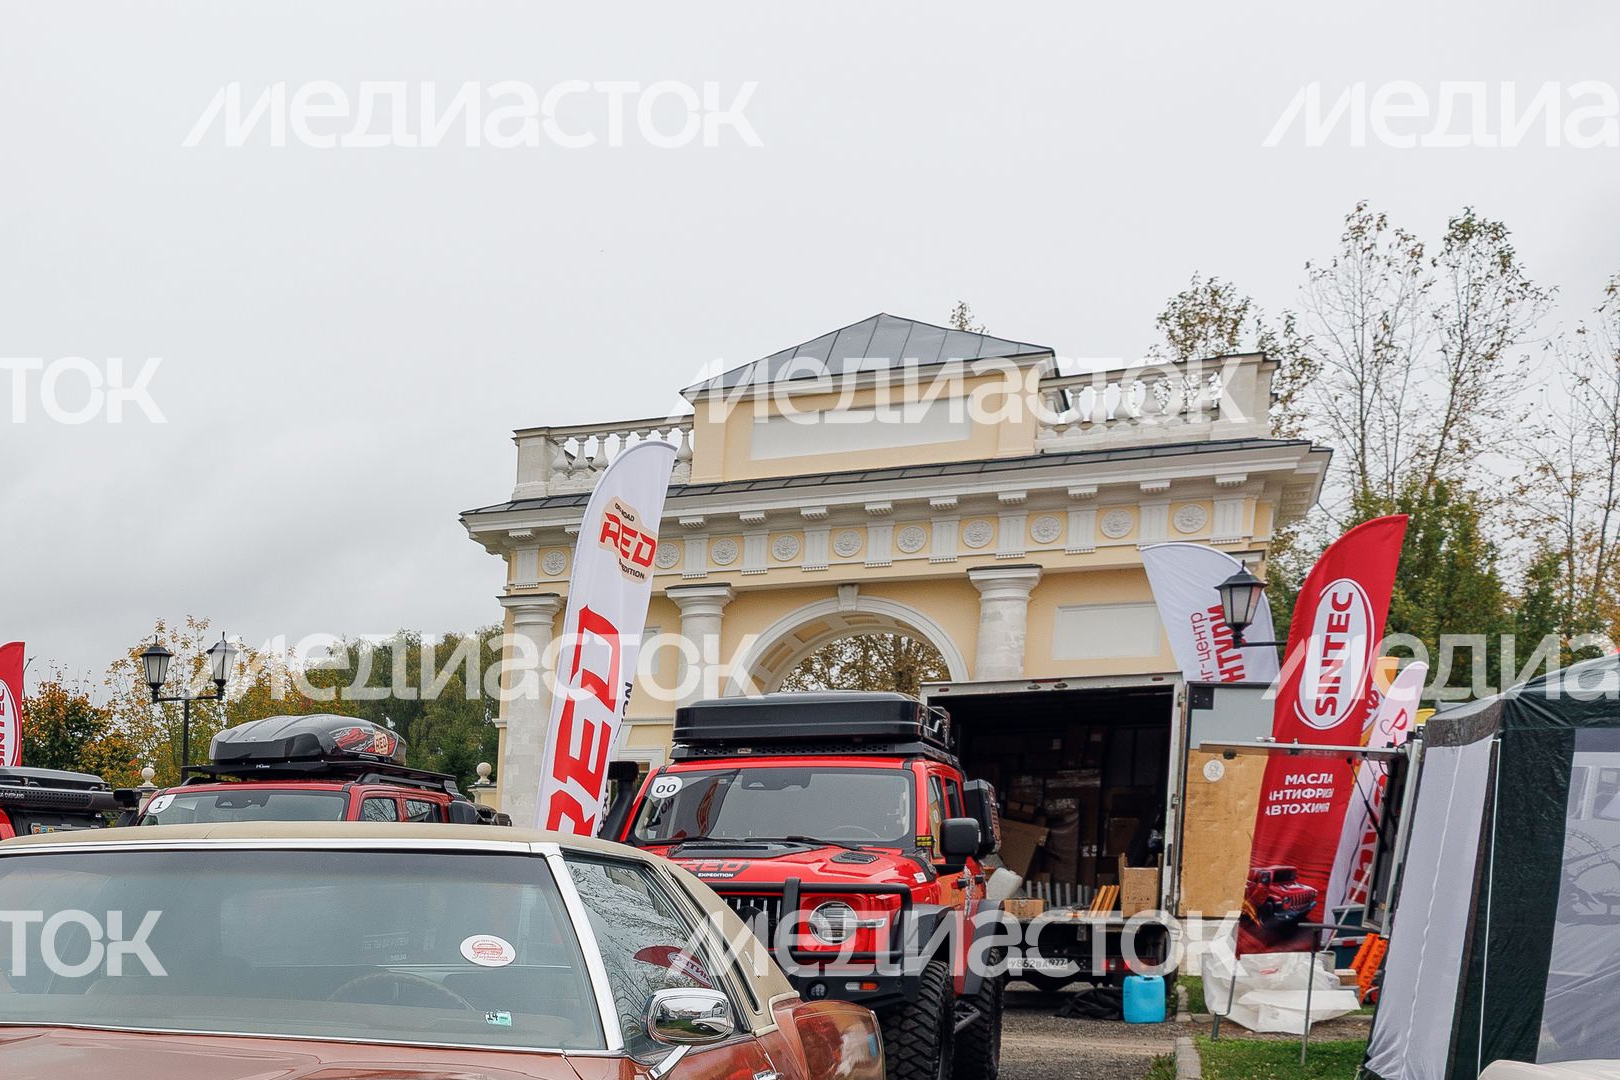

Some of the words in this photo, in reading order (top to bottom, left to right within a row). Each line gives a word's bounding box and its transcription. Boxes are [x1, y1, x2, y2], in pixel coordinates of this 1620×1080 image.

[600, 512, 656, 567] RED
[1315, 592, 1353, 717] SINTEC
[1285, 773, 1333, 786] МАСЛА
